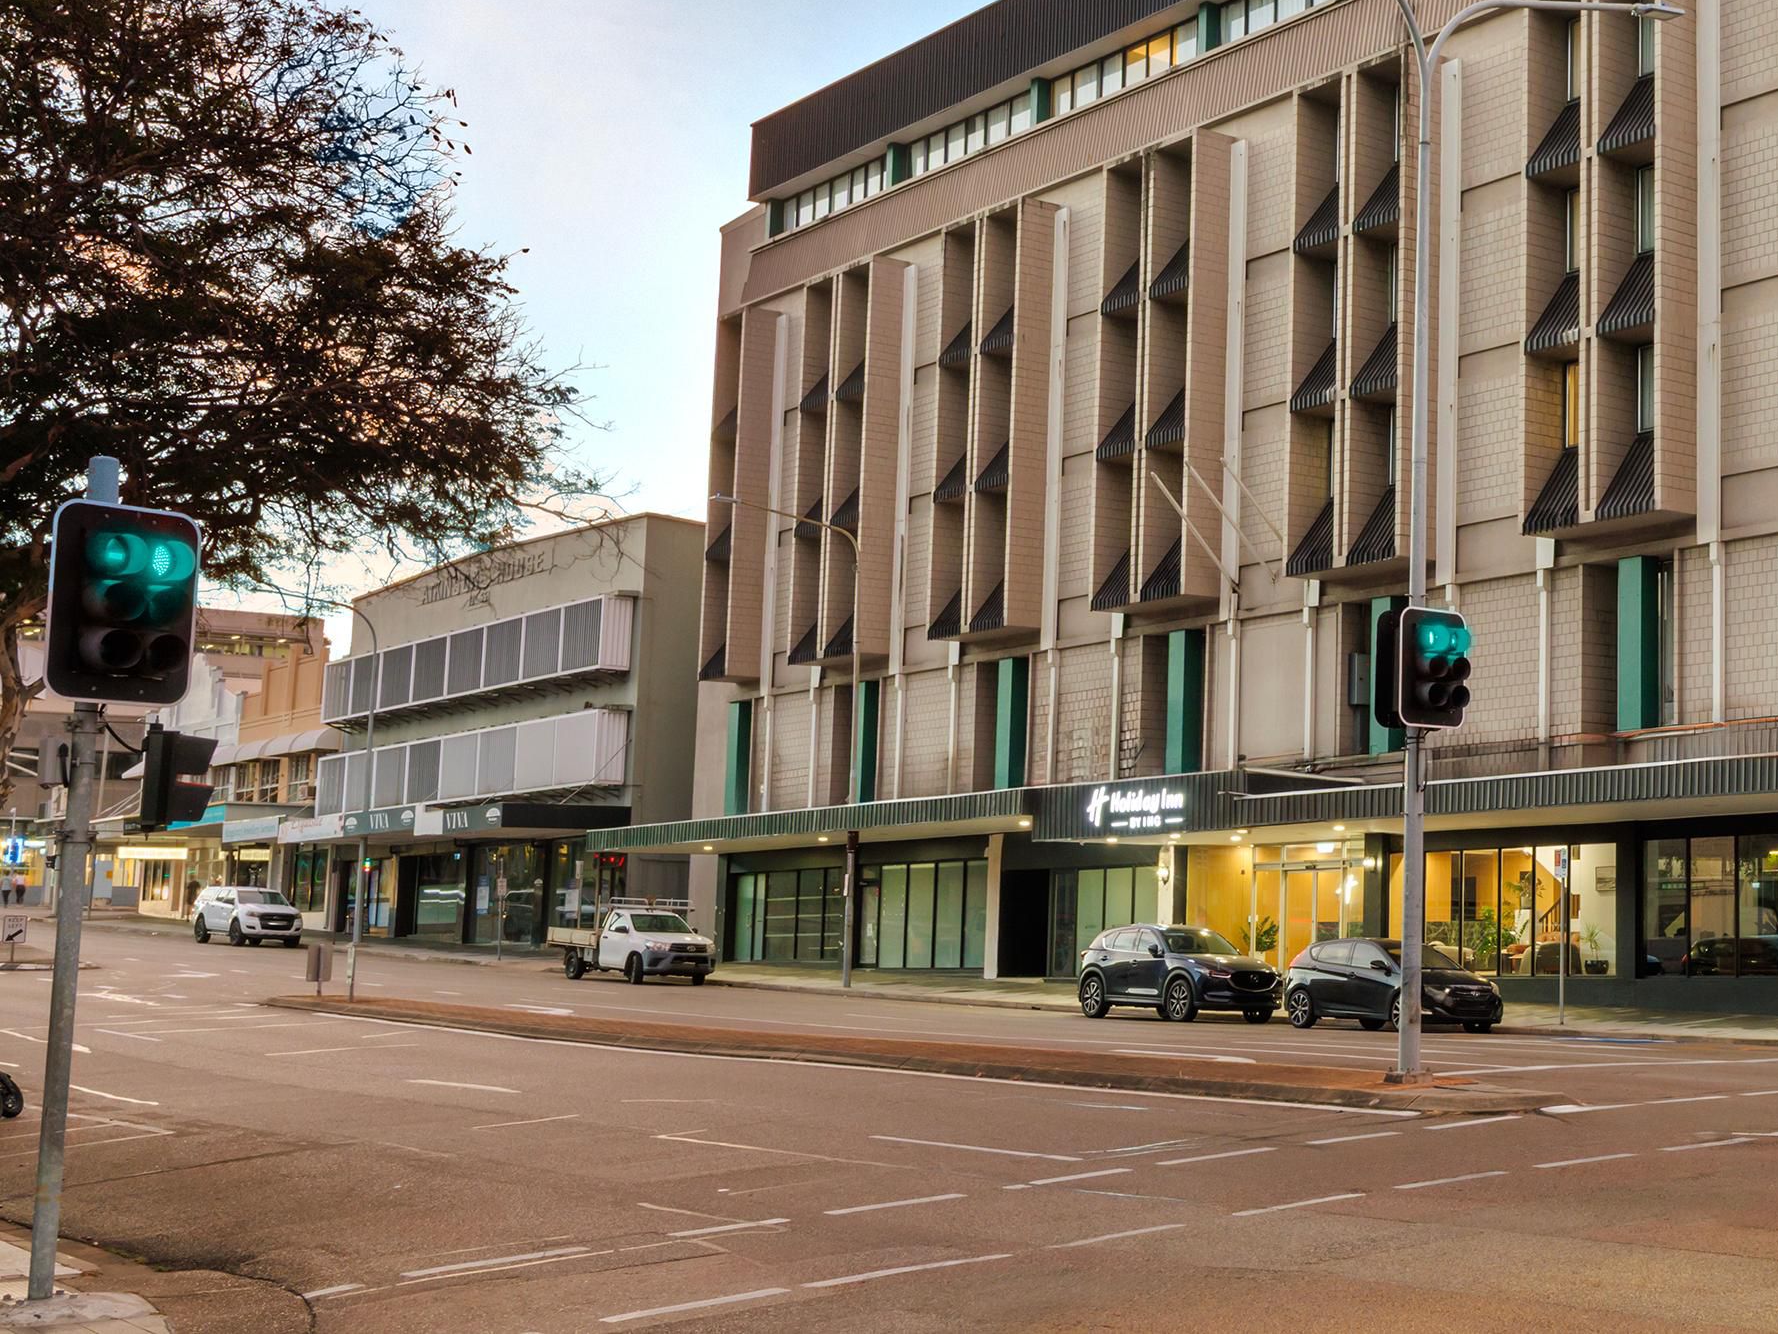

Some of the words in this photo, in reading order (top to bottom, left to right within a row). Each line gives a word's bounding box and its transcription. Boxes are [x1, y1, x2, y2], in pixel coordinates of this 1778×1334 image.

[1110, 789, 1160, 814] Holiday
[1161, 787, 1184, 809] Inn
[369, 812, 390, 829] VIVA
[446, 811, 469, 829] VIVA
[1129, 816, 1141, 829] BY
[1142, 815, 1161, 828] IHG
